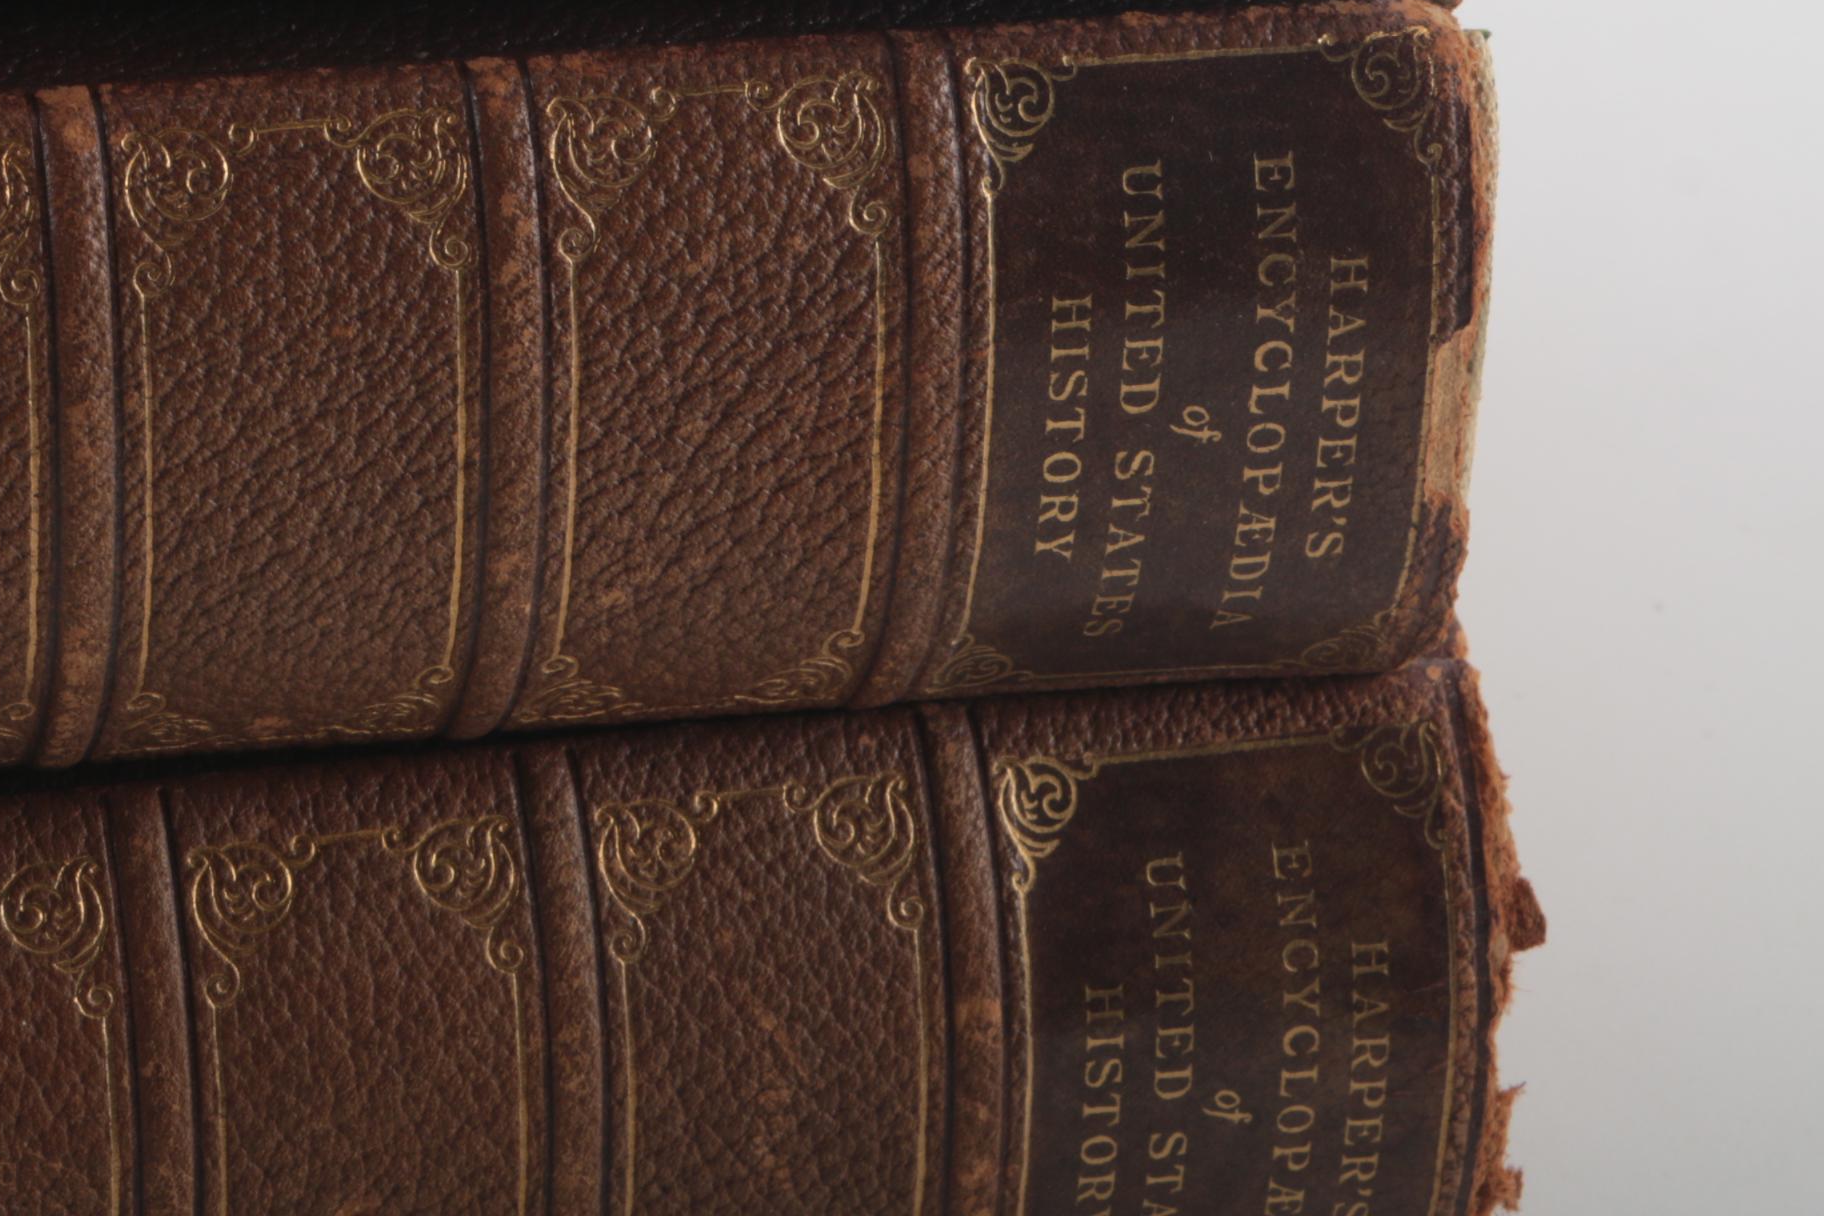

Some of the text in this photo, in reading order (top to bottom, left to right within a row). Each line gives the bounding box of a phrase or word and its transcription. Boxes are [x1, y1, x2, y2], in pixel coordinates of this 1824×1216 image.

[1035, 295, 1091, 559] HISTORY
[1083, 160, 1165, 637] UNITED STATES
[1170, 405, 1222, 443] of
[1209, 151, 1296, 627] ENCYCLOPÆDIA
[1305, 257, 1368, 558] HARPER'S
[1077, 986, 1125, 1216] HISTOR
[1145, 852, 1194, 1100] UNITED
[1203, 1089, 1252, 1124] of
